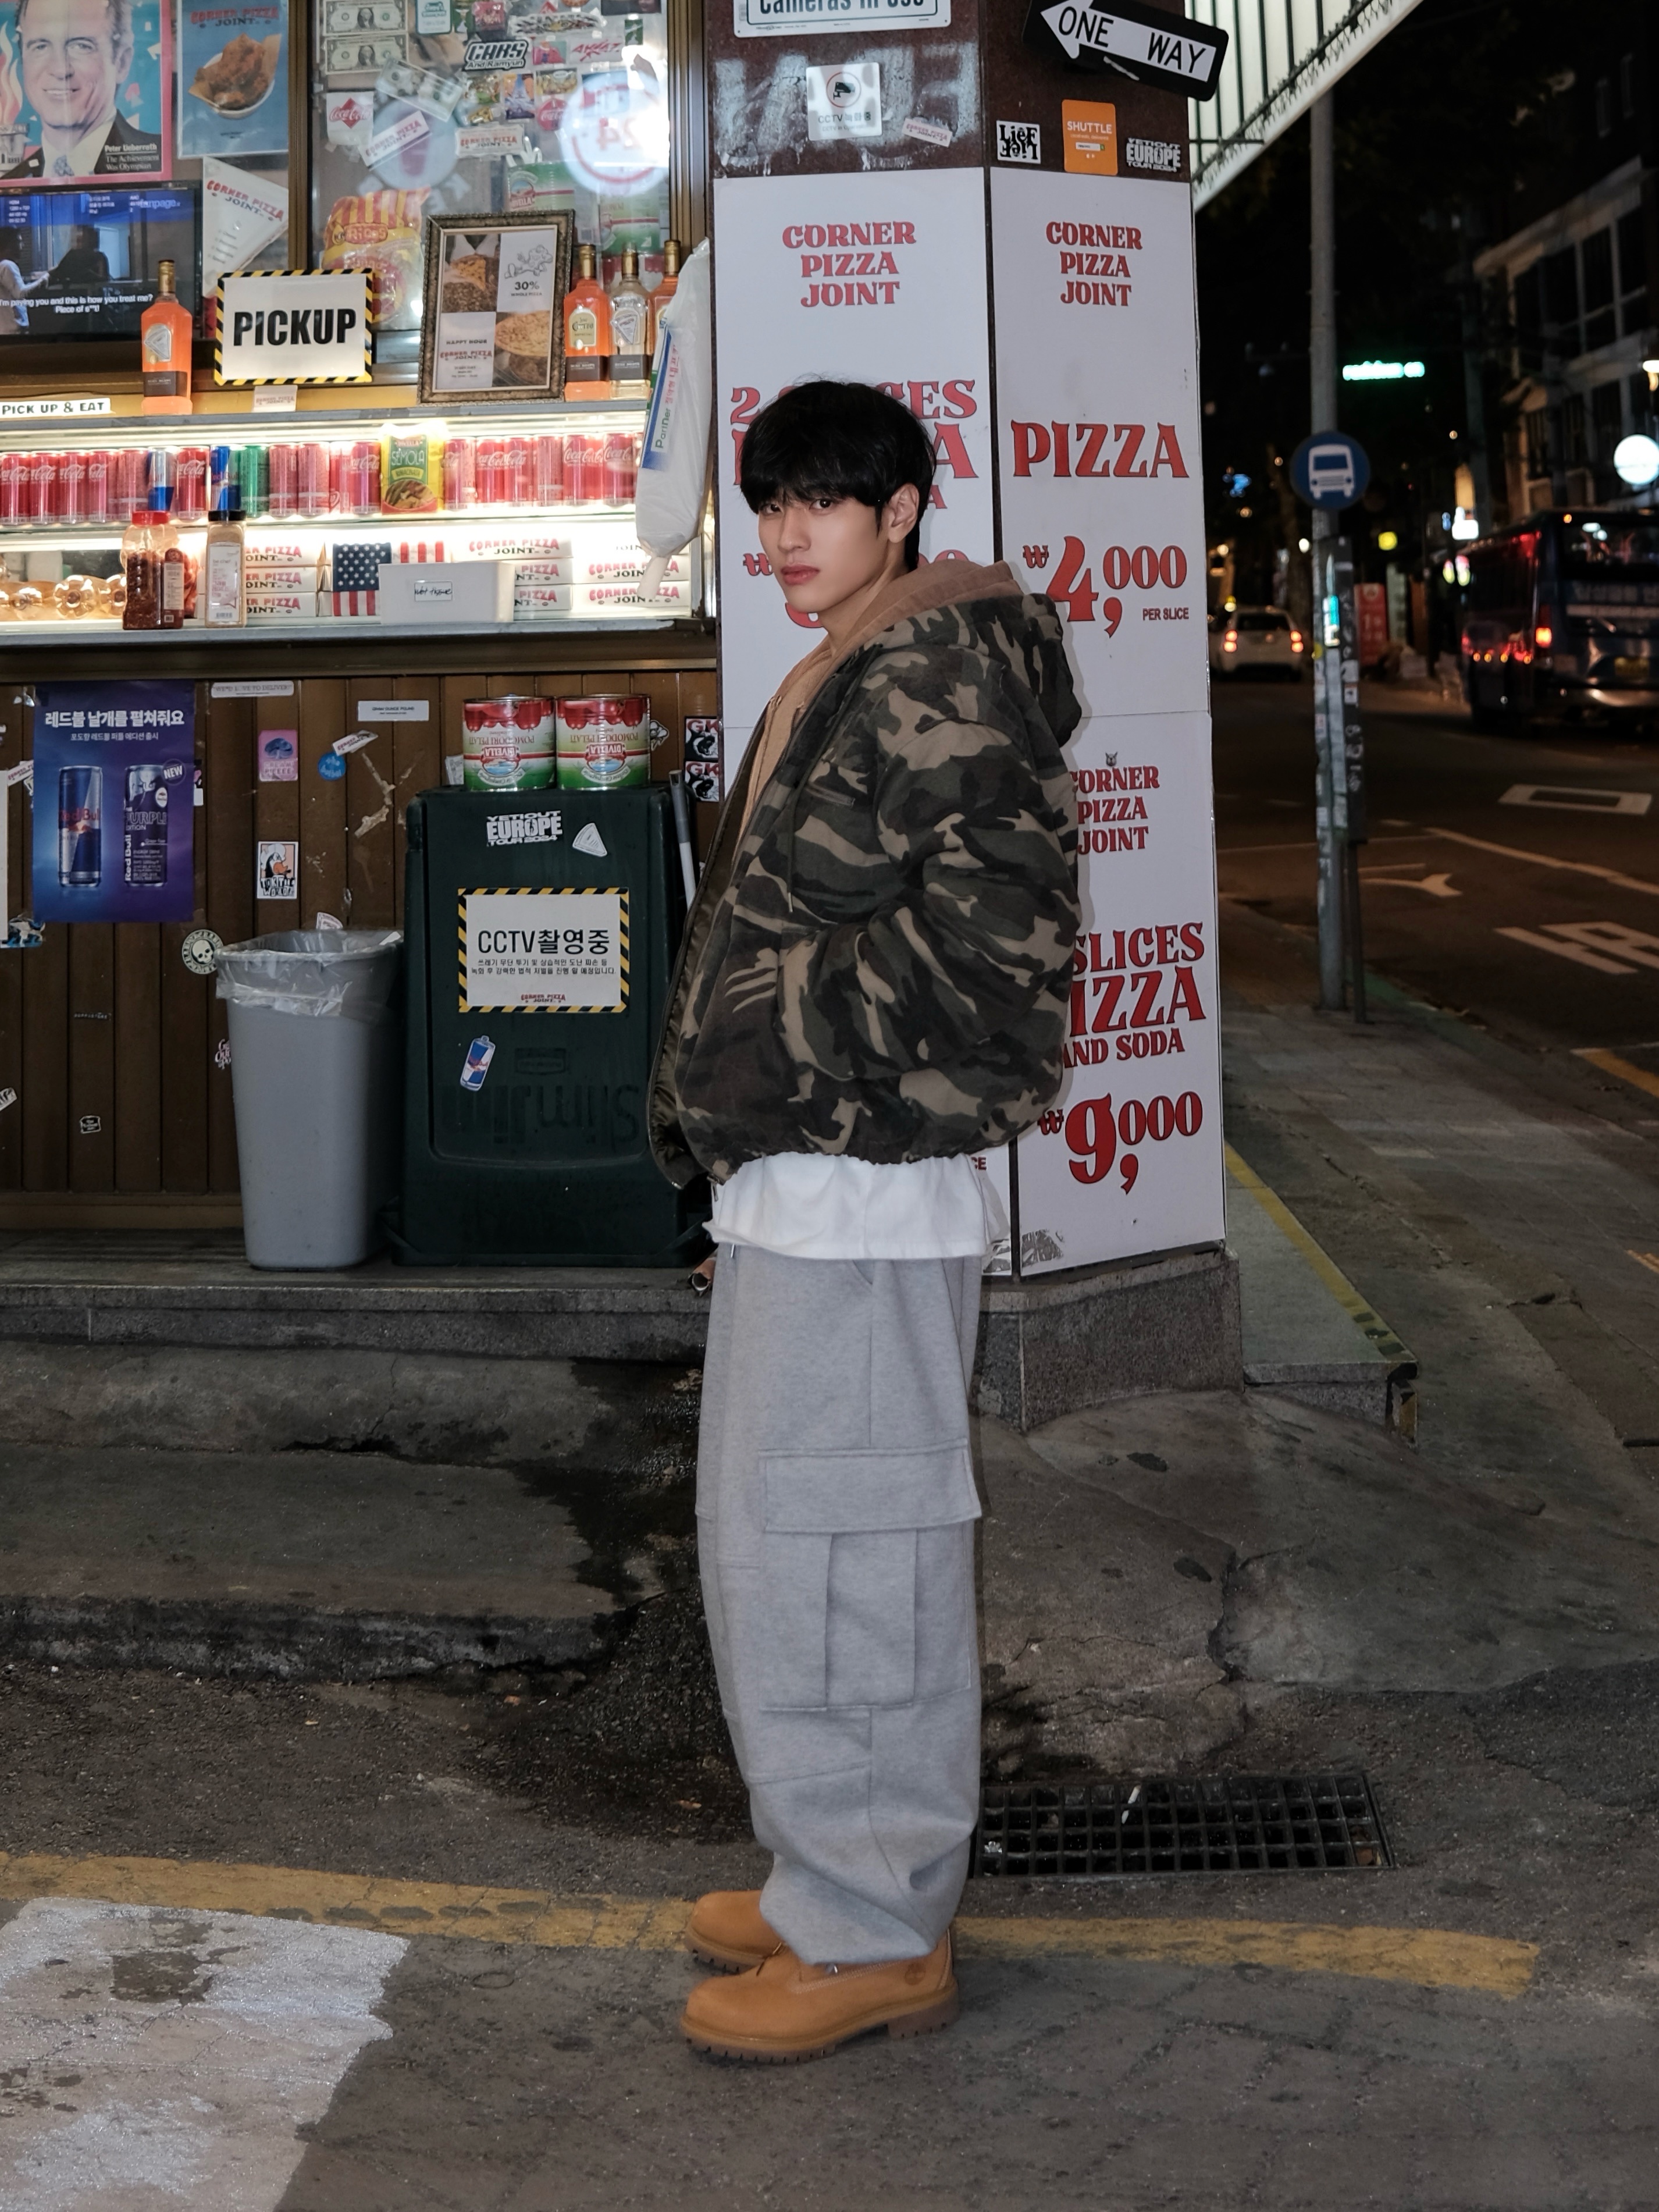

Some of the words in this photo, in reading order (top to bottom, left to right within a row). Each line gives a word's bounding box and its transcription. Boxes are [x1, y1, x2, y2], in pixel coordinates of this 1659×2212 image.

[215, 17, 256, 26] JOINT
[1059, 6, 1115, 48] ONE
[1147, 31, 1206, 74] WAY
[818, 113, 843, 124] CCTV
[1067, 120, 1112, 134] SHUTTLE
[105, 144, 121, 152] Peter
[1126, 138, 1180, 150] YETIOUT
[1126, 144, 1181, 168] EUROPE
[1127, 160, 1152, 170] TOUR
[207, 180, 250, 202] CORNER
[252, 198, 284, 222] PIZZA
[225, 197, 262, 215] JOINT
[782, 221, 917, 249] CORNER
[1046, 221, 1144, 251] CORNER
[801, 251, 899, 278] PIZZA
[1059, 250, 1131, 278] PIZZA
[514, 281, 540, 291] 30%
[800, 280, 900, 308] JOINT
[1060, 280, 1133, 307] JOINT
[10, 298, 34, 309] paying
[35, 298, 49, 308] you
[50, 296, 65, 305] and
[65, 296, 79, 305] this
[79, 296, 87, 304] is
[87, 295, 103, 304] how
[104, 296, 118, 305] you
[119, 294, 136, 303] treat
[137, 294, 154, 303] me?
[55, 305, 74, 314] Piece
[234, 308, 357, 346] PICKUP
[2, 404, 34, 415] PICK
[41, 404, 58, 413] UP
[63, 402, 73, 412] &
[80, 401, 105, 412] EAT
[730, 387, 761, 425] 2
[655, 407, 672, 450] Partner
[1010, 419, 1190, 478] PIZZA
[265, 546, 302, 559] PIZZA
[469, 539, 517, 553] CORNER
[522, 538, 560, 550] PIZZA
[521, 563, 560, 577] PIZZA
[589, 561, 636, 575] CORNER
[613, 570, 646, 578] JOIN
[265, 572, 302, 585] PIZZA
[519, 589, 557, 603] PIZZA
[613, 595, 646, 603] JOIN
[264, 597, 301, 610] PIZZA
[1142, 608, 1161, 621] PER
[1163, 607, 1190, 620] SLICE
[45, 711, 86, 728] 레드불
[88, 709, 129, 728] 날개를
[130, 709, 185, 727] 펼쳐줘요
[70, 732, 90, 742] 포도향
[91, 732, 111, 741] 레드불
[125, 731, 145, 741] 에디션
[469, 735, 490, 745] PELATI
[570, 732, 594, 742] PELATI
[599, 732, 639, 742] POMODOI
[590, 744, 622, 755] DIVELLA
[163, 764, 183, 780] NEW
[486, 810, 561, 822] YETIOUT
[1077, 795, 1148, 824] PIZZA
[486, 816, 563, 840] EUROPE
[487, 837, 524, 847] TOUR
[524, 834, 558, 843] 2024
[1077, 826, 1149, 855] JOINT
[478, 929, 610, 954] CCTV촬영중
[1072, 921, 1205, 975] SLICES
[1069, 964, 1206, 1037] IZZA
[1116, 1027, 1185, 1061] SODA
